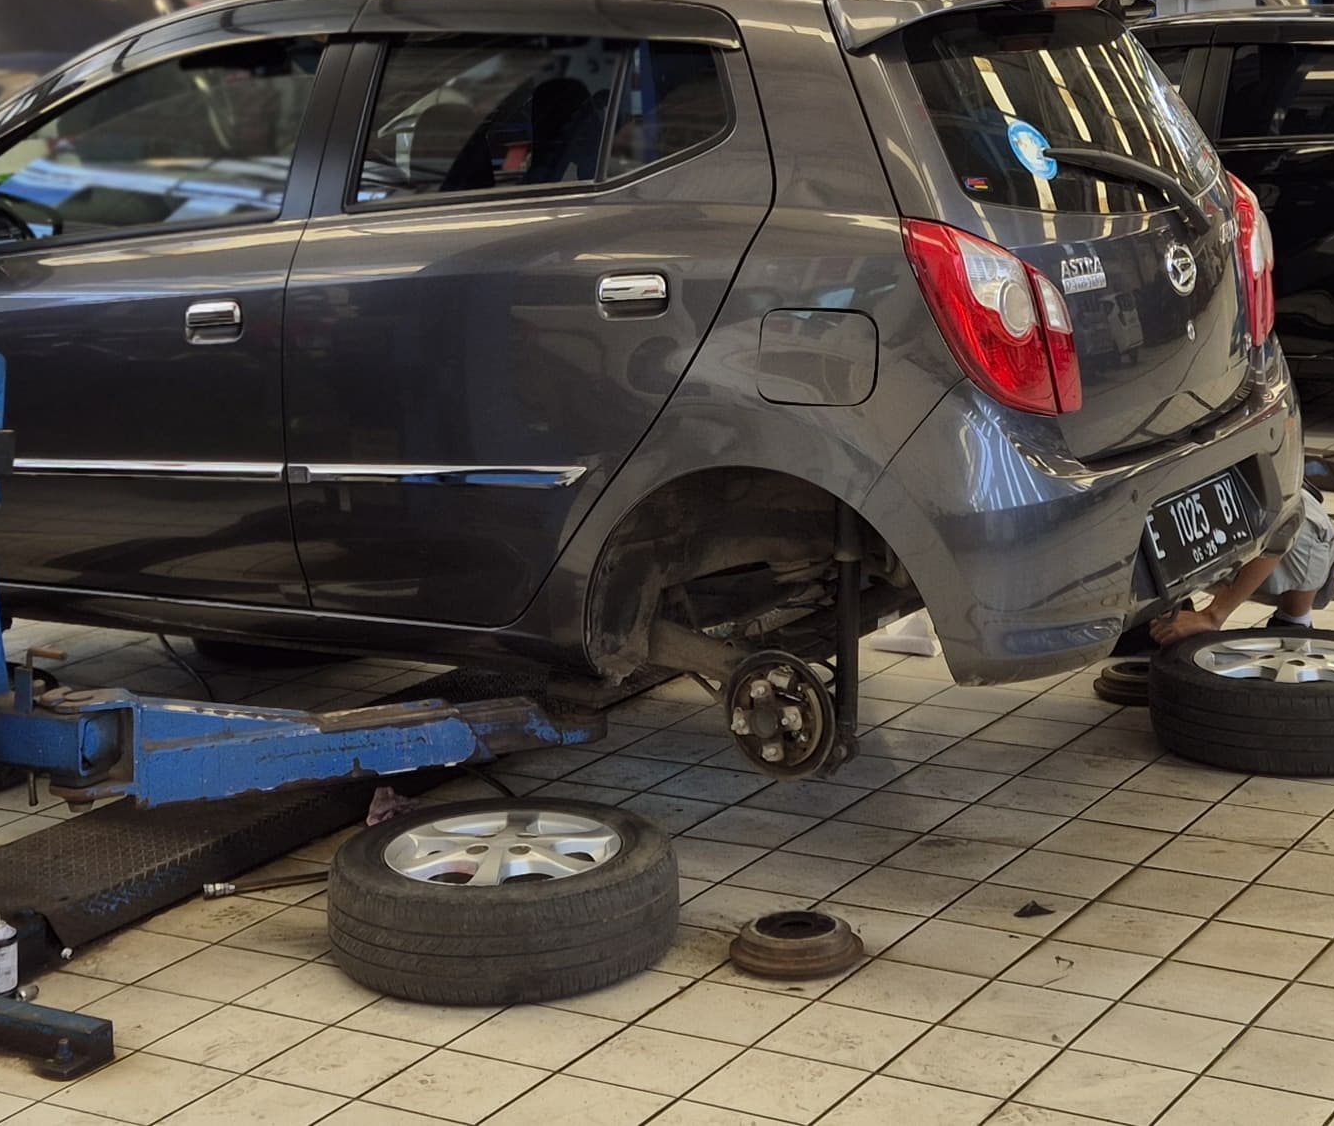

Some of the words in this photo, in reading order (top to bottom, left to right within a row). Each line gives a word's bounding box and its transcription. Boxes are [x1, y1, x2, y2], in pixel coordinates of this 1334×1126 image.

[1061, 255, 1105, 279] ASTRA
[1146, 514, 1166, 560] E
[1170, 493, 1210, 547] 1025
[1214, 478, 1240, 525] BY
